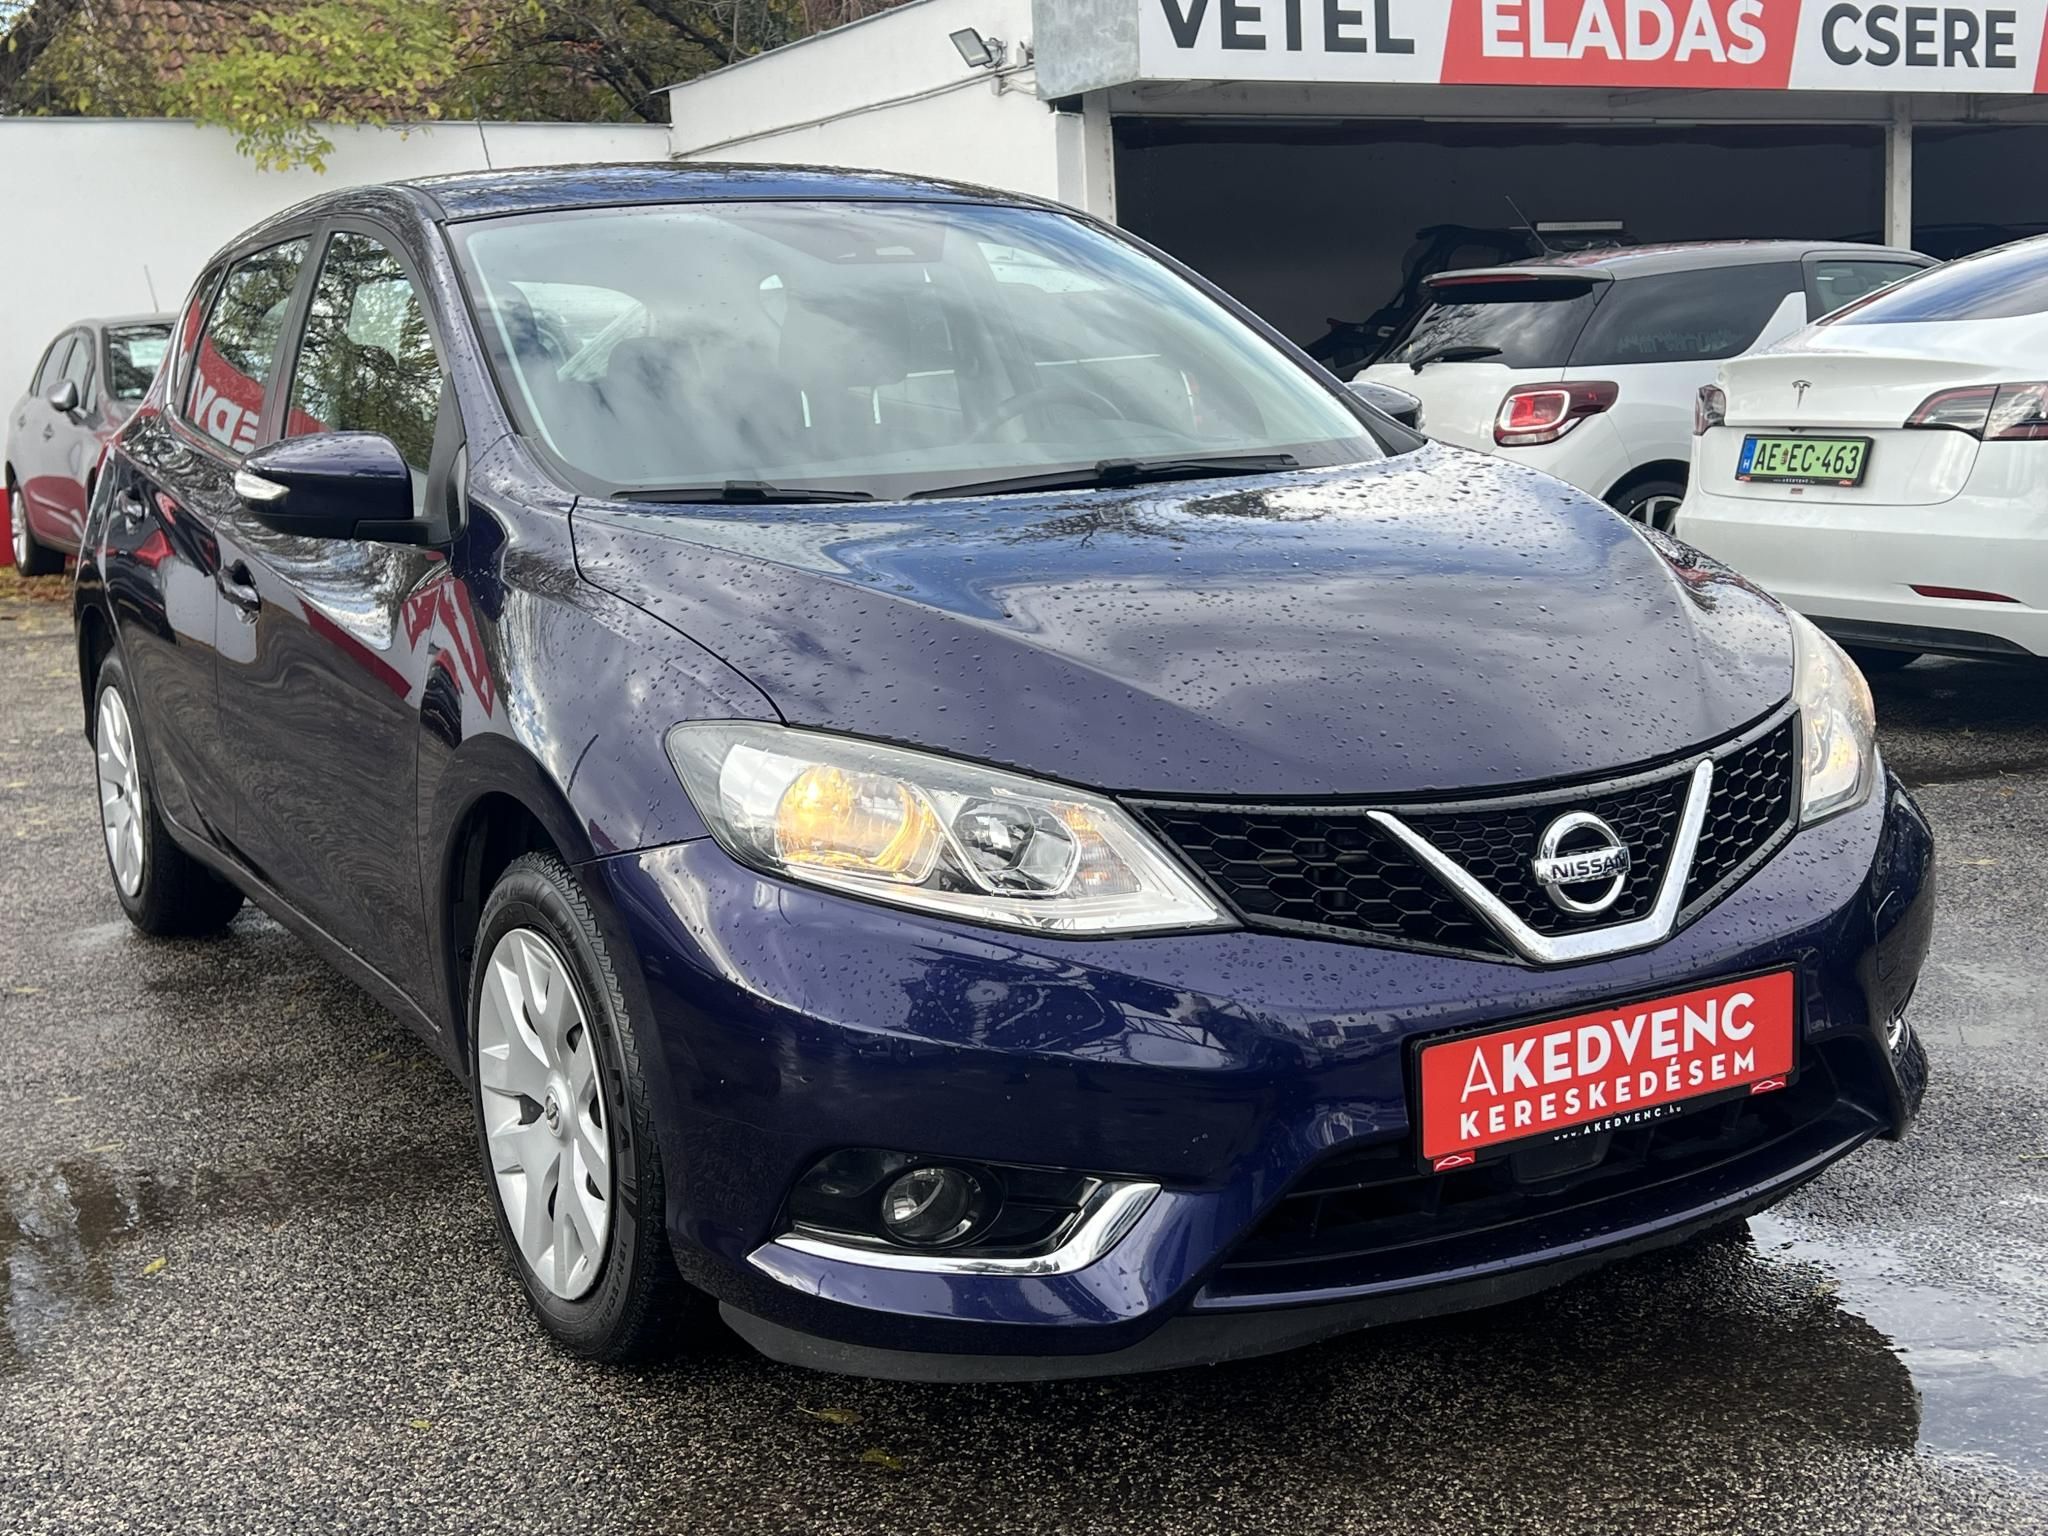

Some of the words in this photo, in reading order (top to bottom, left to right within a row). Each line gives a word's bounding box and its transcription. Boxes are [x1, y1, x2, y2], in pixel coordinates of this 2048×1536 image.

[1822, 3, 2016, 68] CSERE
[1753, 443, 1782, 471] AE
[1551, 851, 1627, 879] NISSAN
[1459, 1047, 1756, 1140] KERESKEDÉSEM
